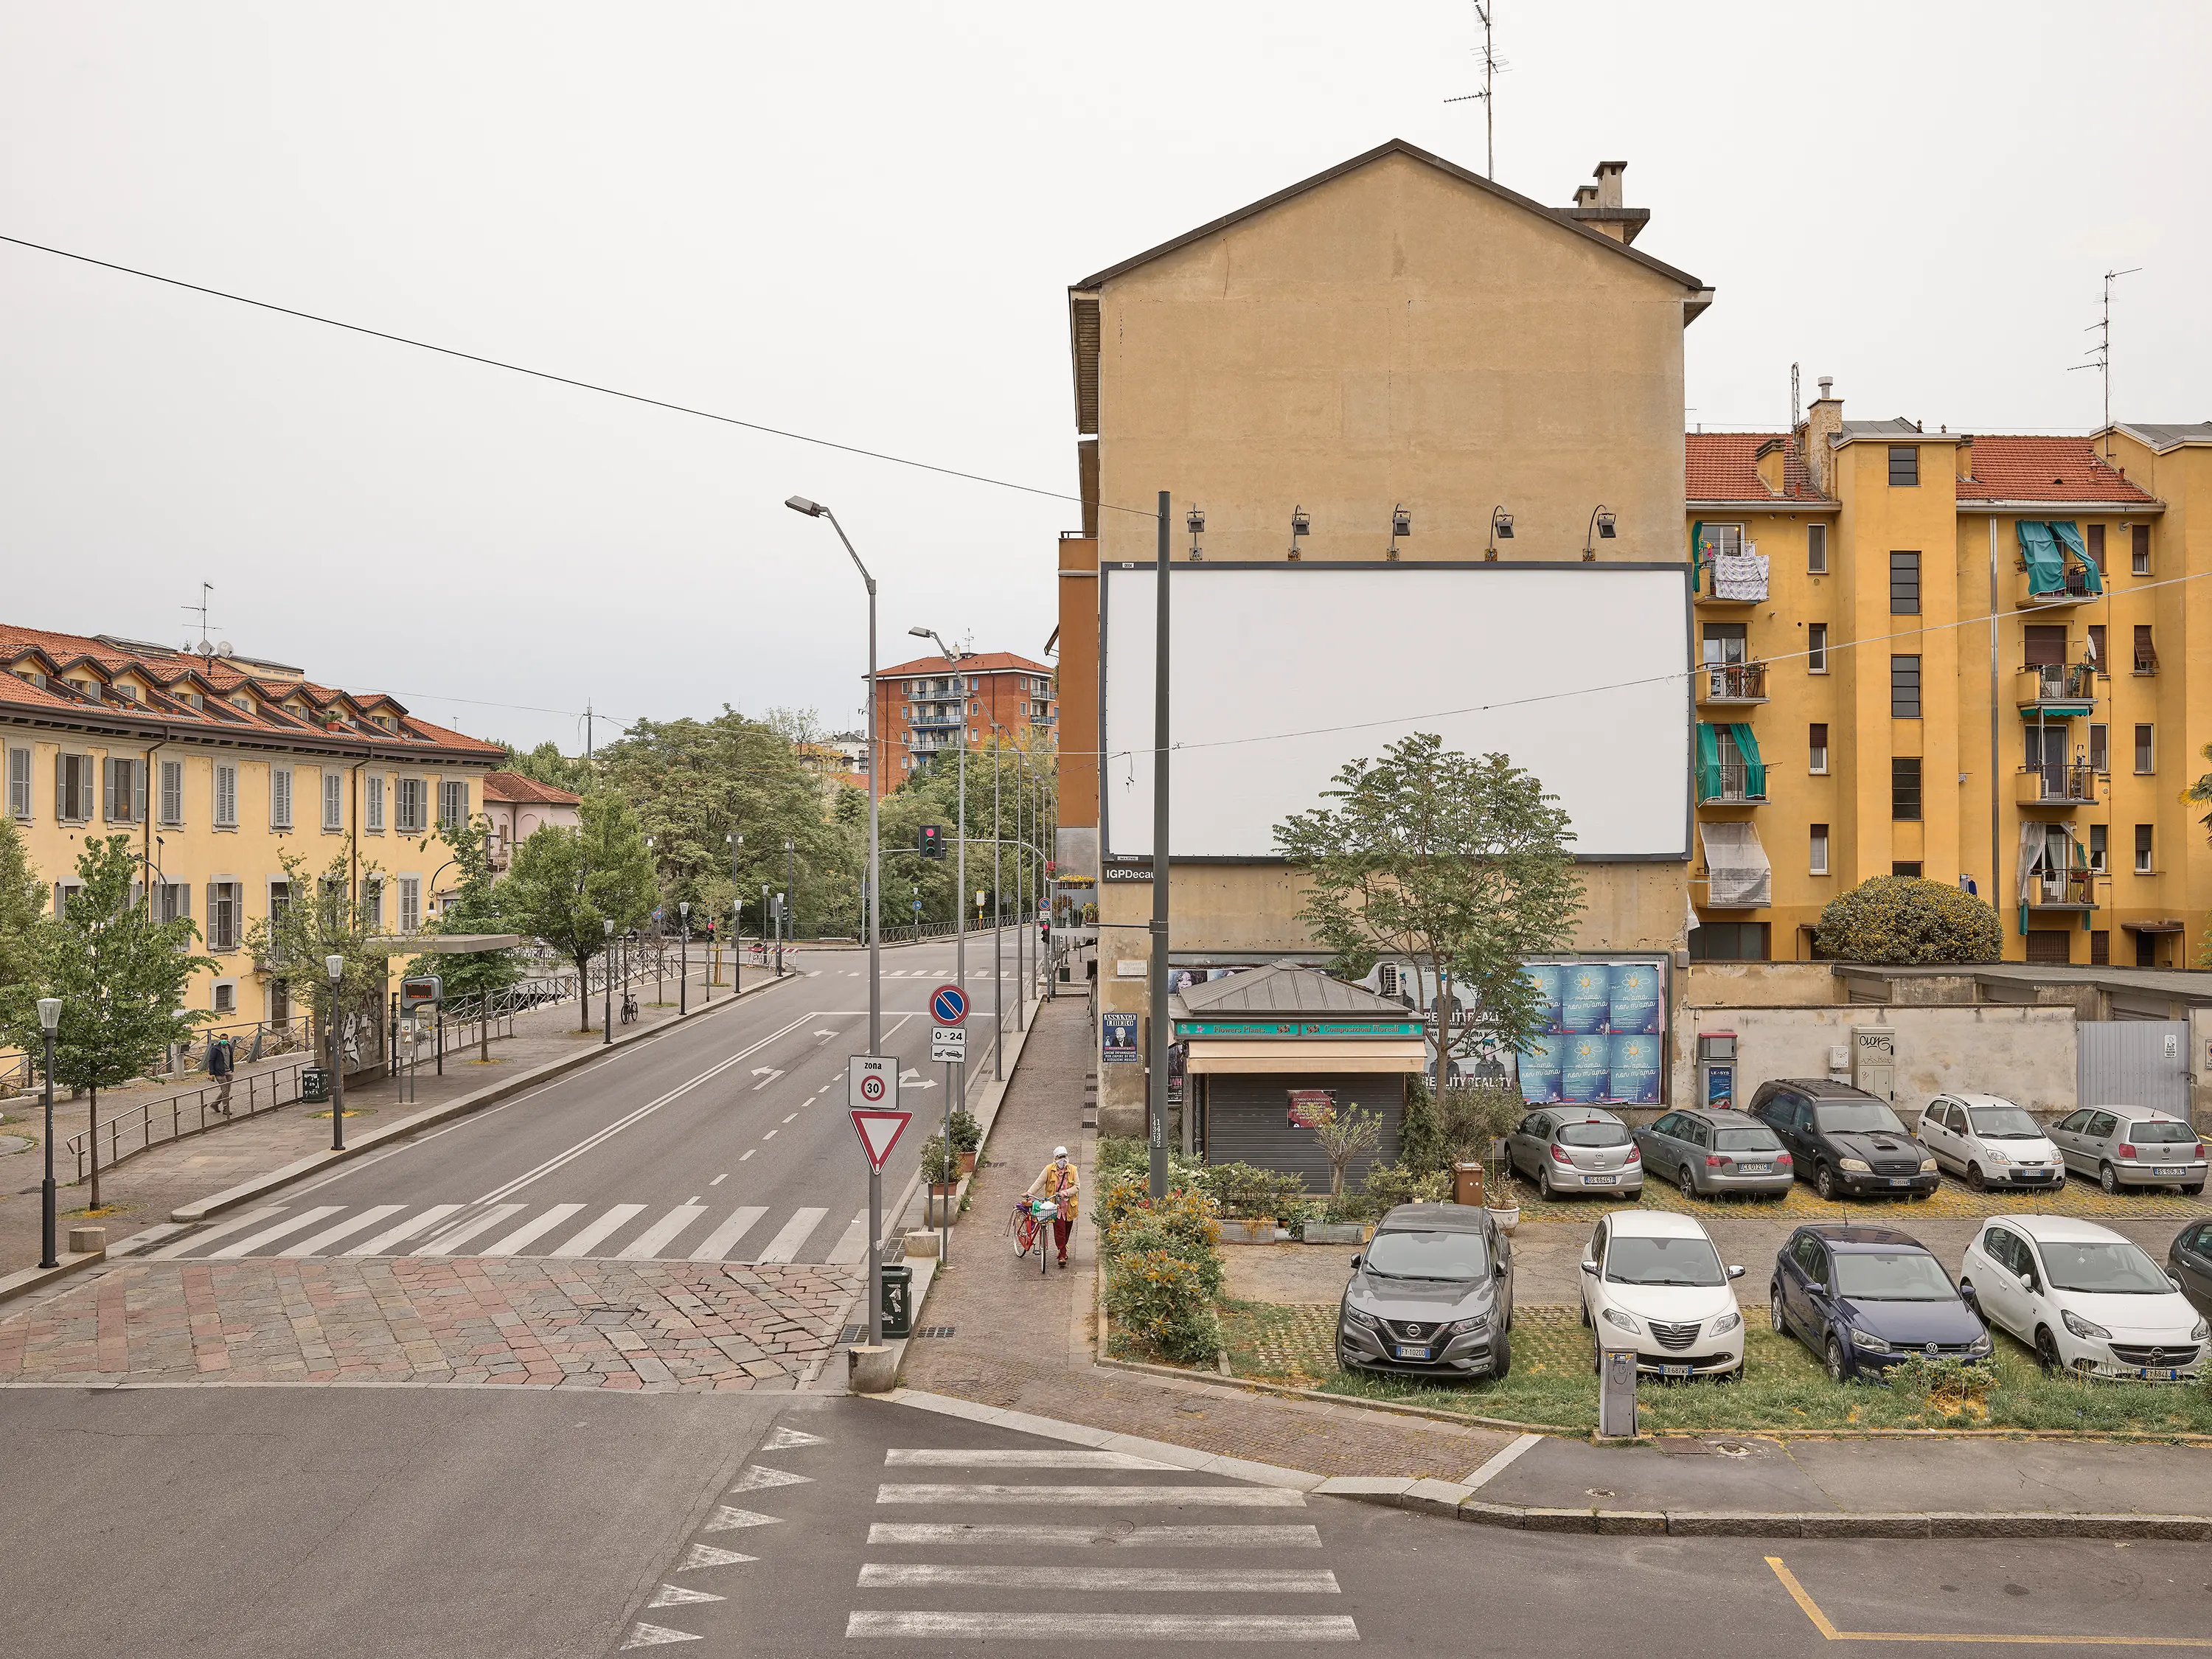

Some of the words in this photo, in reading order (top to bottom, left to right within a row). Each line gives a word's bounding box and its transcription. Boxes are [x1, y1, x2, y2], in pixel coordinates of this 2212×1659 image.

[1424, 1012, 1467, 1022] REITY
[1243, 1026, 1271, 1034] Plants...
[1324, 1025, 1371, 1034] Composizioni
[1372, 1025, 1399, 1033] Floreali
[935, 1032, 942, 1040] 0
[950, 1032, 962, 1040] 24
[867, 1083, 879, 1093] 30
